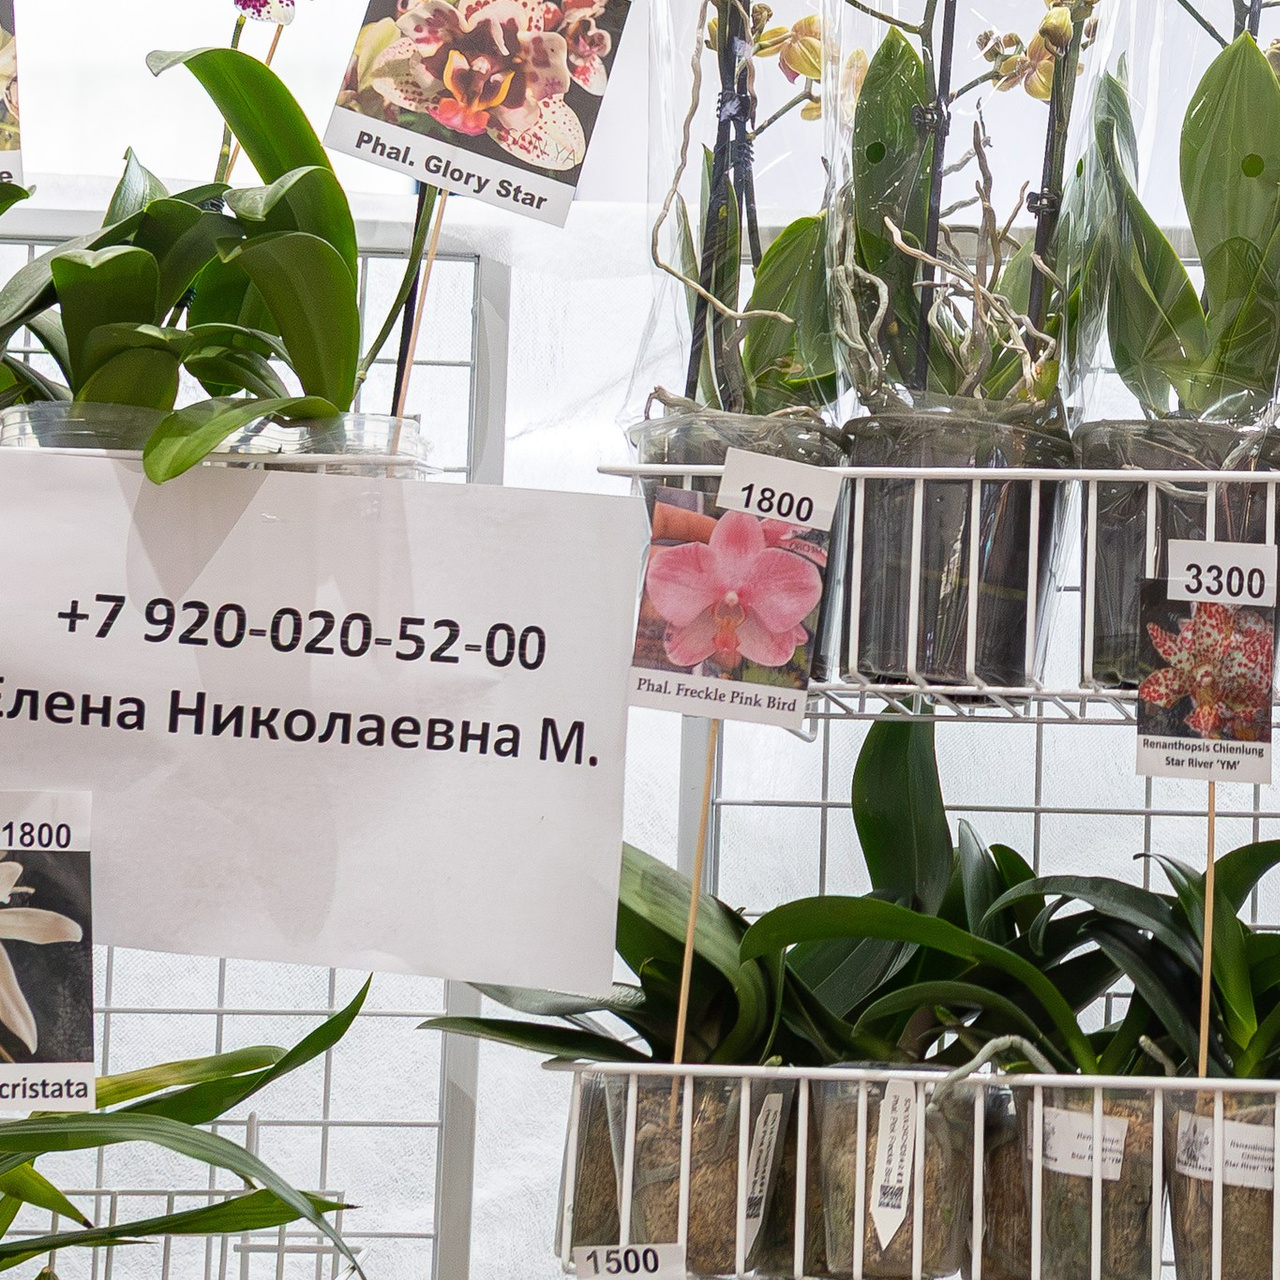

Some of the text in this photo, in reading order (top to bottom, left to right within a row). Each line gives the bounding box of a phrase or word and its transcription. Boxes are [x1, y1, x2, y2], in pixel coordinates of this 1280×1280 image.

[355, 130, 548, 210] Phal. Glory Star
[740, 482, 814, 522] 1800
[1184, 563, 1266, 599] 3300
[57, 593, 547, 671] +7 920-020-52-00
[636, 677, 797, 713] Phal. Freckle Pink Bird
[0, 676, 599, 767] лена Николаевна М.
[1142, 739, 1264, 758] Renanthopsis Chienlung
[1165, 756, 1184, 767] Star
[1188, 757, 1214, 769] River
[2, 821, 71, 849] 1800
[0, 1077, 88, 1099] cristata
[586, 1248, 659, 1274] 1500
